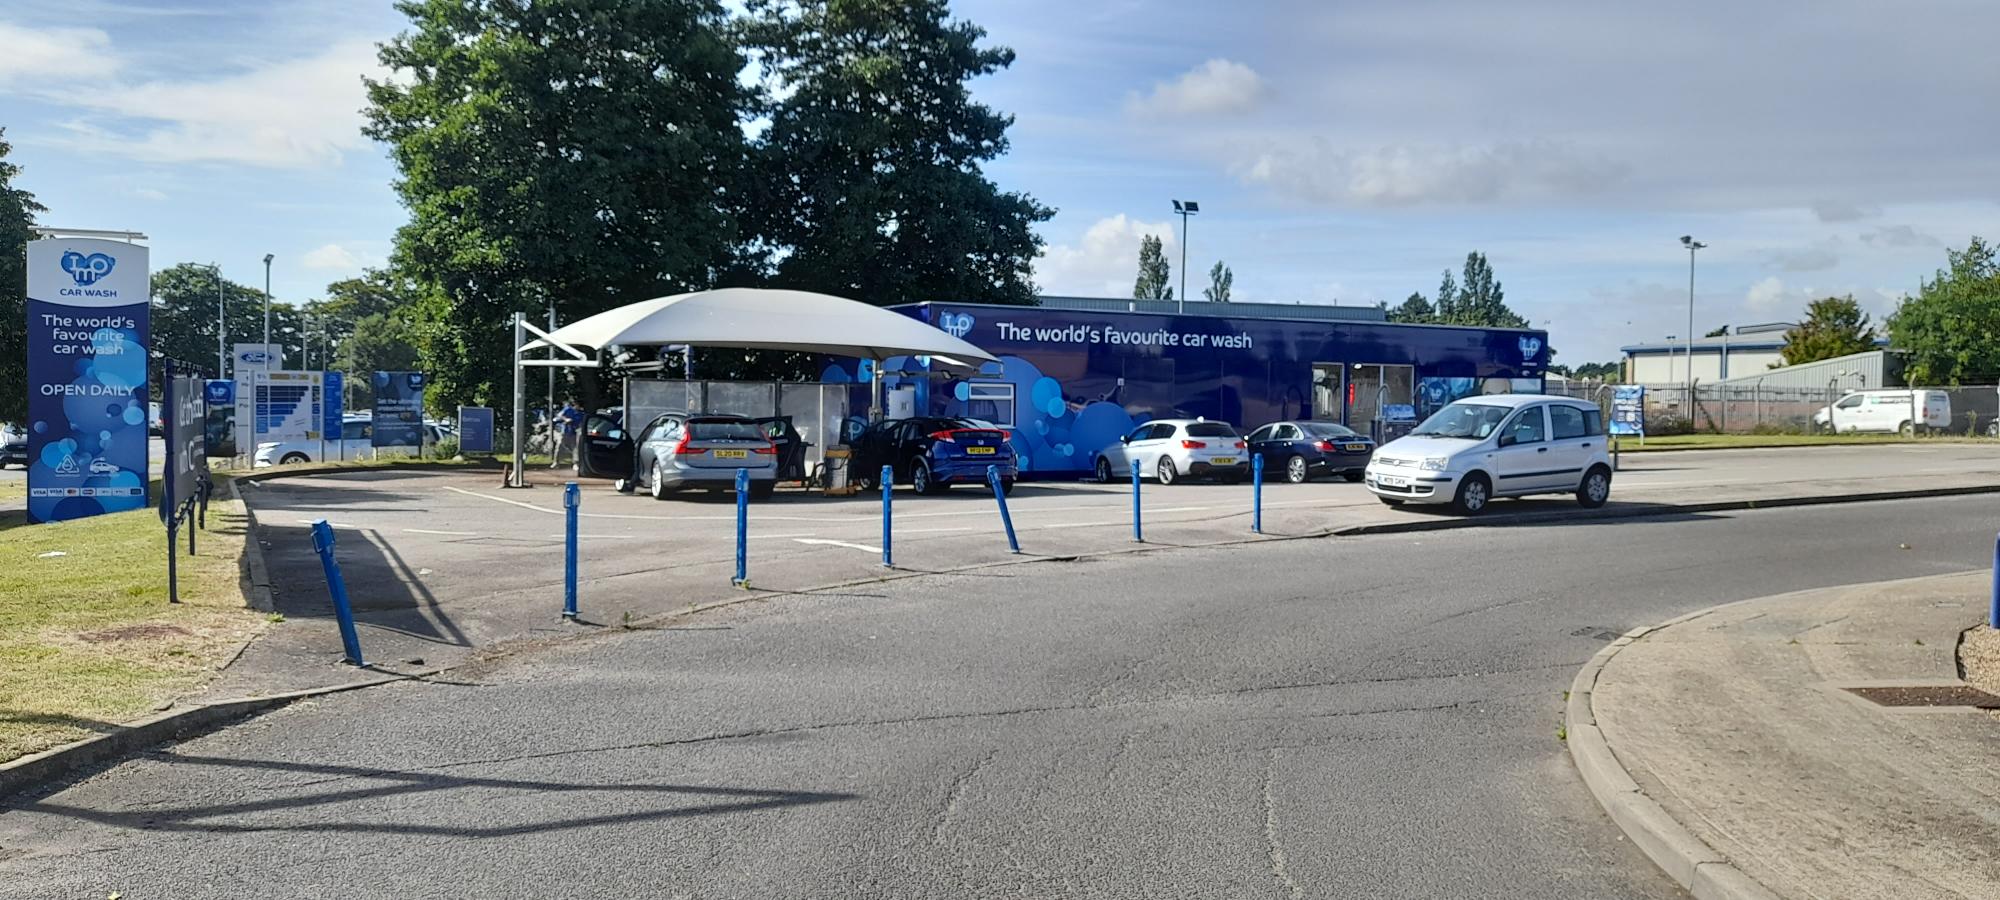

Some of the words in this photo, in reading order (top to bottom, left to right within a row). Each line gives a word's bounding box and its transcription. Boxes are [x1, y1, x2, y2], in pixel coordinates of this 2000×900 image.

[60, 288, 82, 296] CAR
[85, 289, 117, 297] WASH
[42, 314, 72, 327] The
[76, 316, 135, 329] world's
[53, 328, 125, 341] favourite
[996, 322, 1031, 341] The
[1035, 325, 1100, 344] world's
[1104, 326, 1179, 346] favourite
[1182, 333, 1208, 347] car
[1211, 331, 1253, 349] wash
[53, 344, 78, 354] car
[82, 343, 124, 355] wash
[41, 384, 86, 396] OPEN
[90, 384, 135, 397] DAILY
